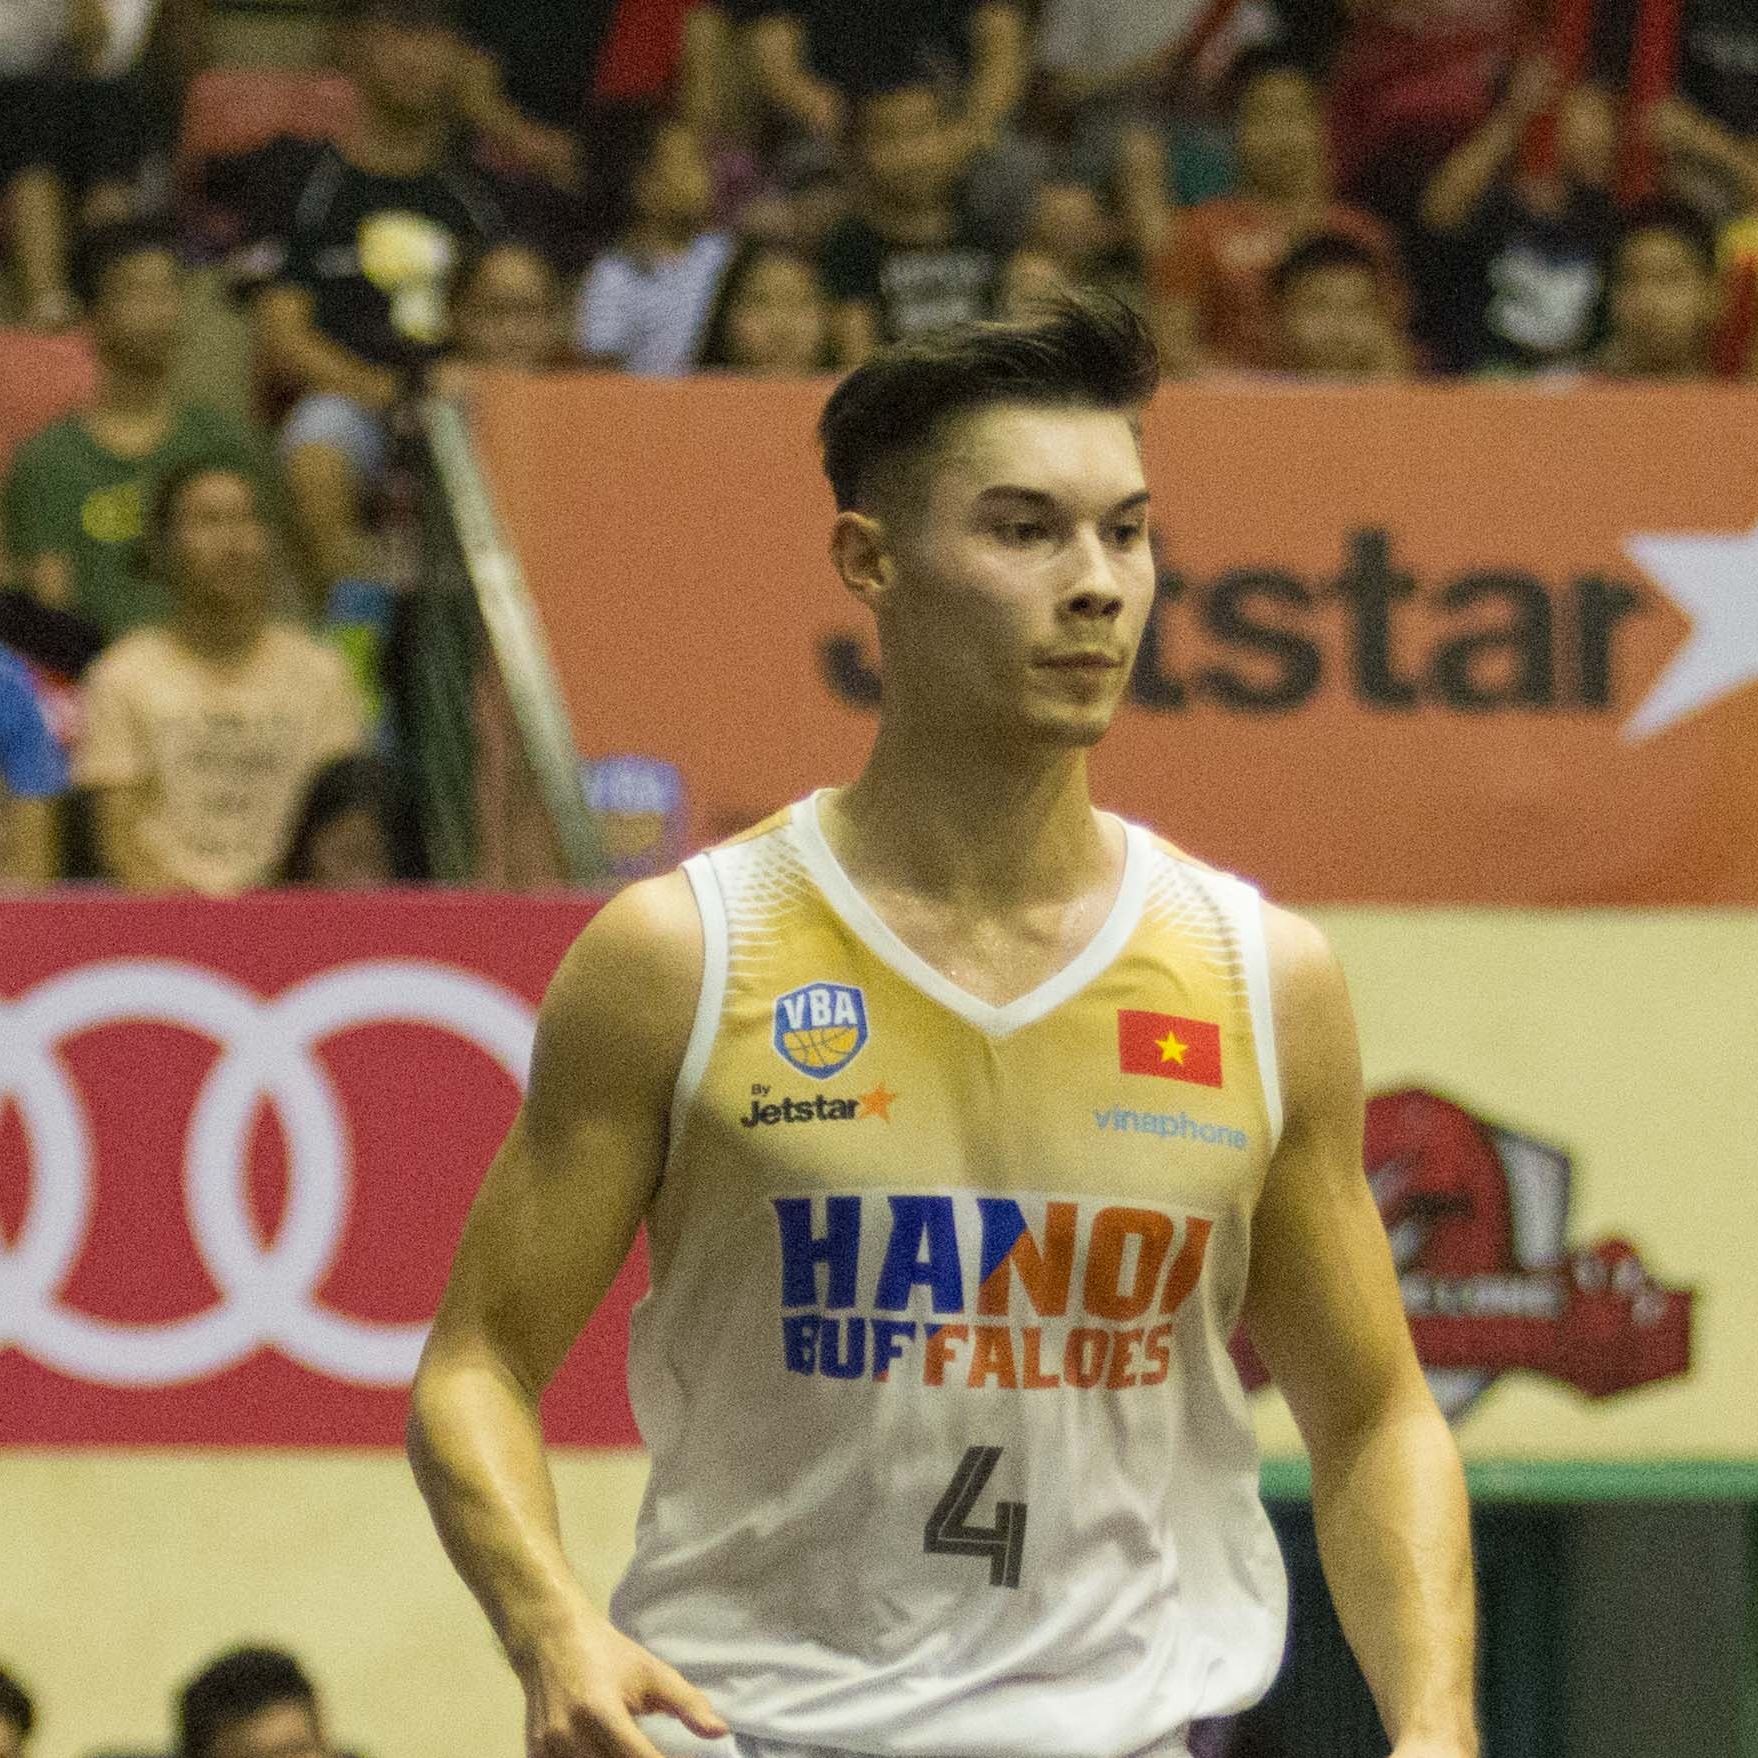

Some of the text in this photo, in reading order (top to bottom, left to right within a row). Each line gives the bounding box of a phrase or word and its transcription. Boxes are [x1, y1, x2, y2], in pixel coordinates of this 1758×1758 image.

[782, 988, 858, 1030] VBA
[741, 1093, 860, 1129] Jetstar
[750, 1083, 772, 1097] By
[1093, 1103, 1248, 1150] vinaphone
[773, 1194, 1215, 1322] HANOI
[782, 1313, 1174, 1390] BUFFALOES
[923, 1444, 1028, 1590] 4
